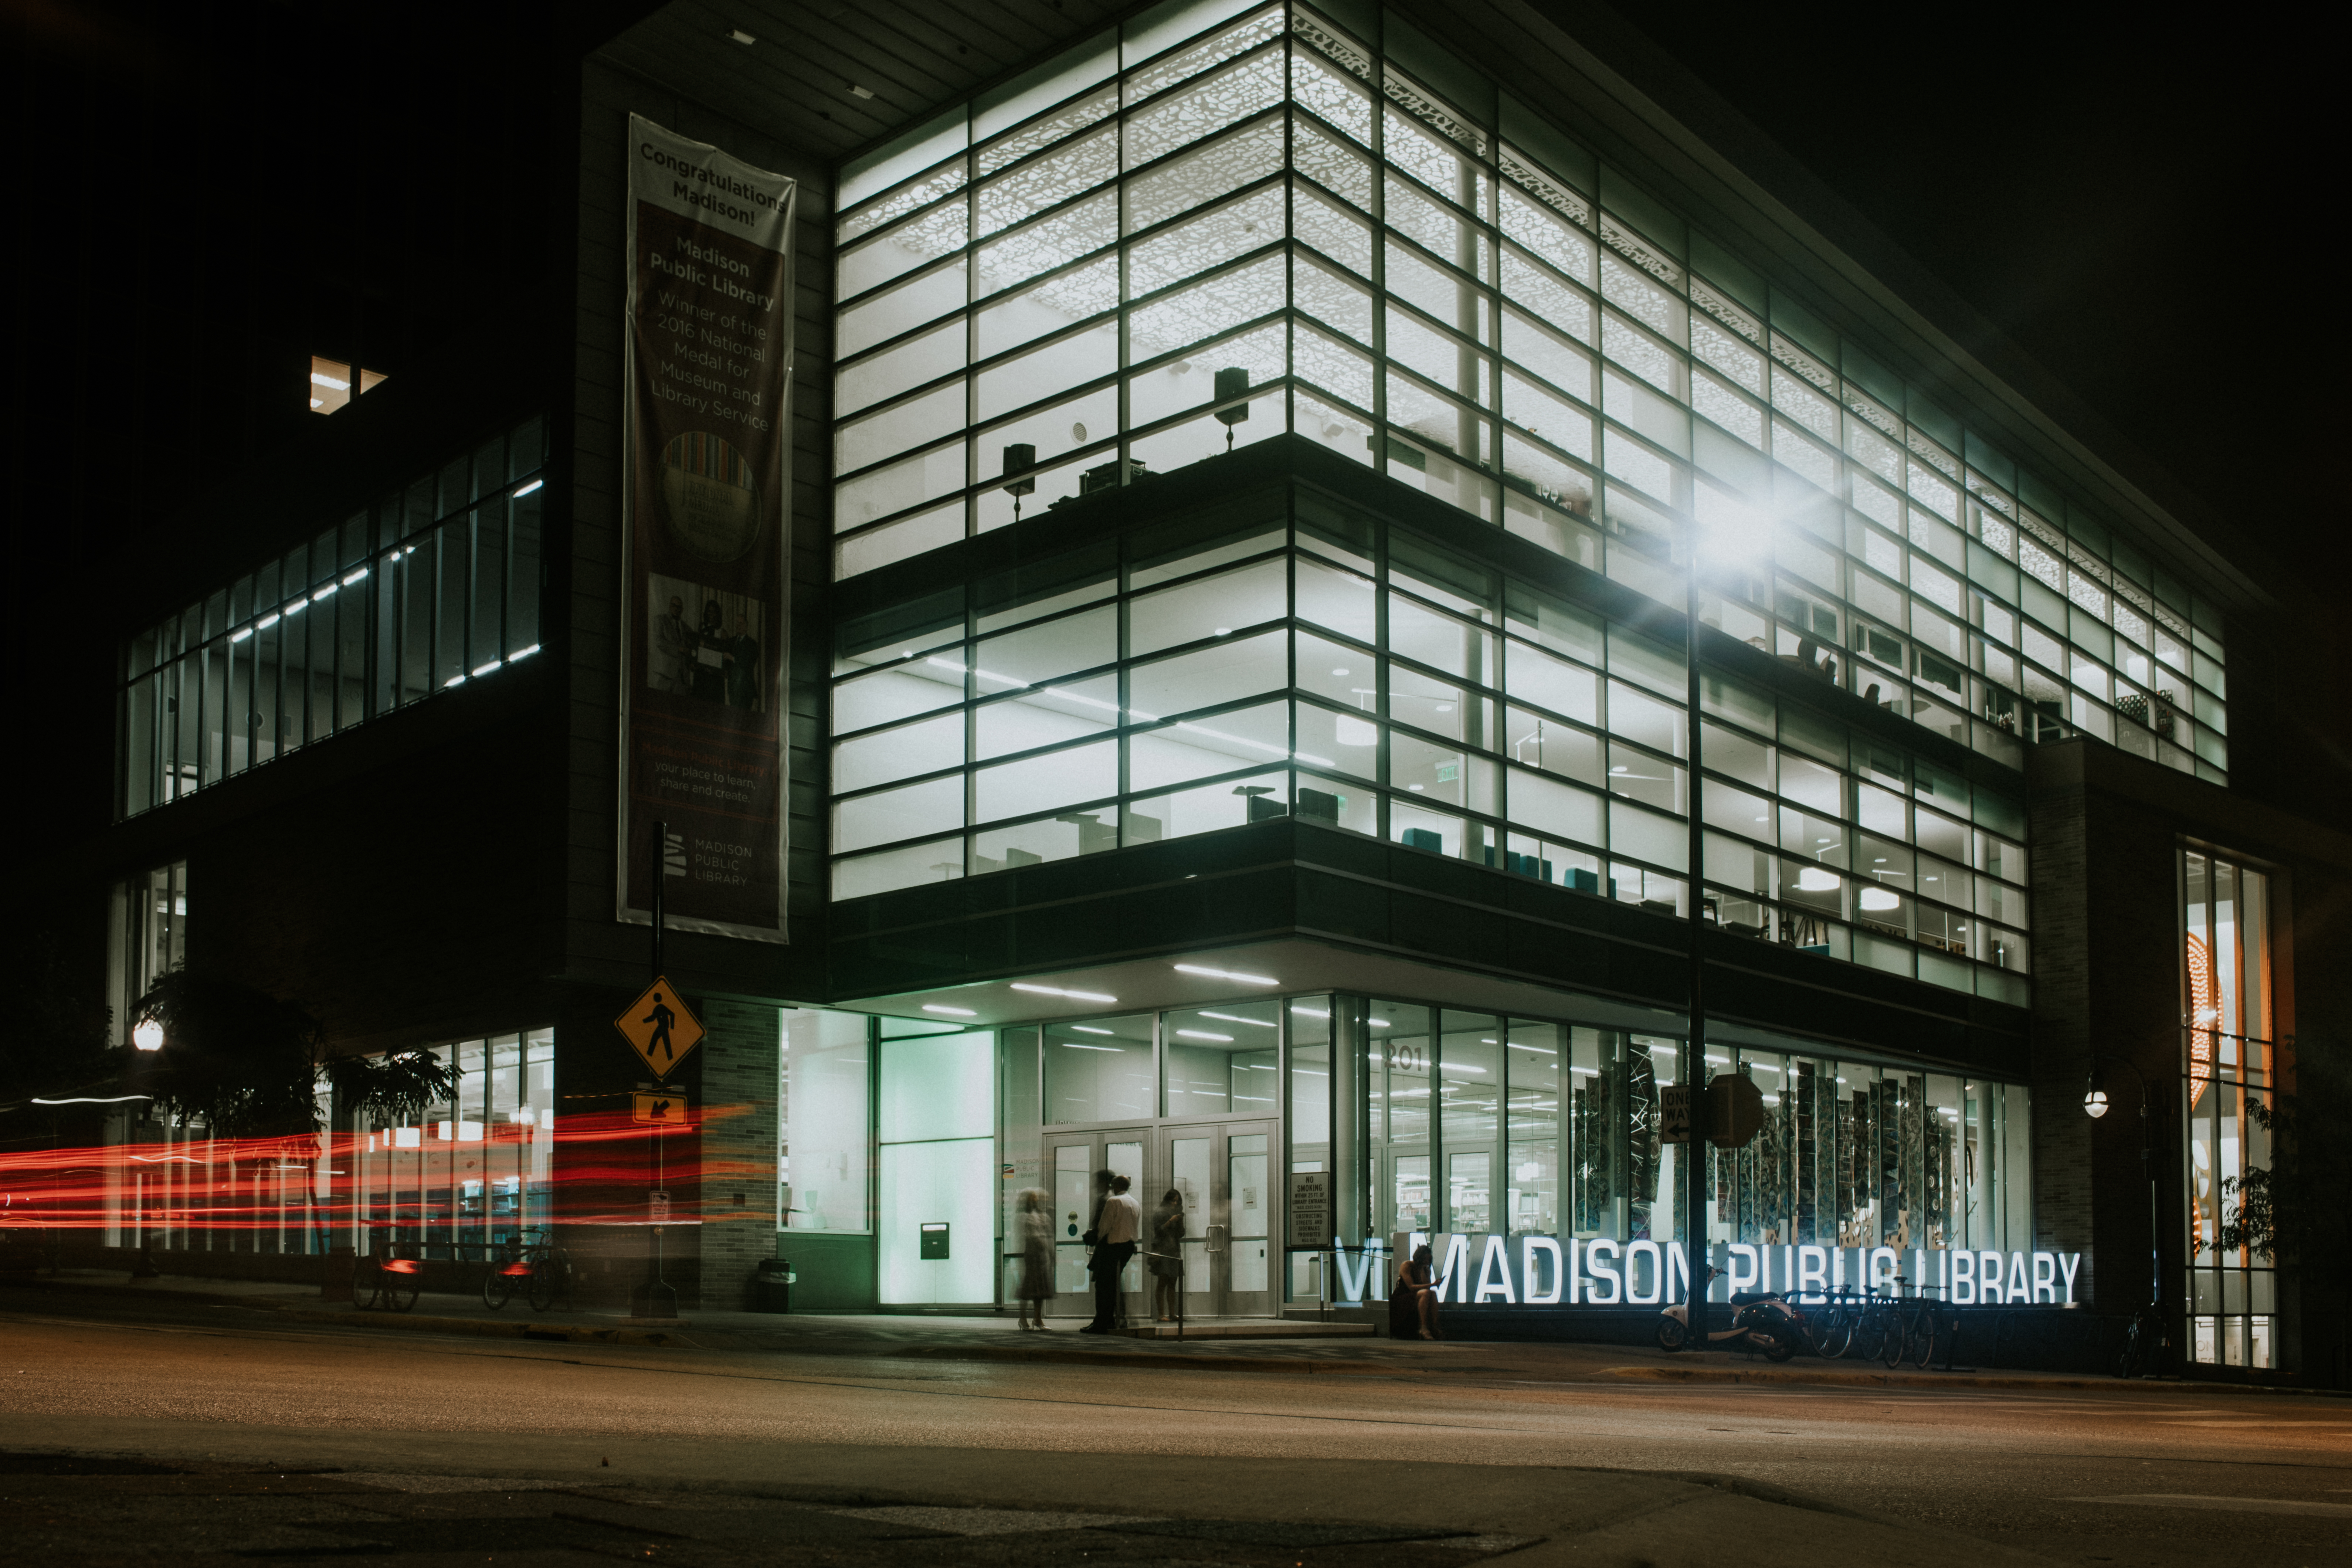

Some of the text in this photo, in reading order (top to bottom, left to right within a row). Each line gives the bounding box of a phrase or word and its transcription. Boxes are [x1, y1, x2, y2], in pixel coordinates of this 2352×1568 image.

[641, 143, 785, 214] Congratulations
[673, 181, 755, 227] Madison!
[678, 237, 749, 278] Madison
[651, 253, 774, 312] Public Library
[658, 290, 767, 340] Winner of the
[658, 313, 765, 363] 2016 National
[675, 343, 750, 379] Medal for
[662, 361, 760, 406] Museum and
[652, 381, 768, 432] Library Service
[642, 742, 687, 759] Madison
[691, 751, 723, 767] Public
[655, 762, 756, 790] your place to learn,
[661, 777, 751, 802] share and create.
[1442, 767, 1455, 780] EXIT
[696, 839, 752, 858] MADISON
[696, 854, 739, 871] PUBLIC
[696, 869, 748, 886] LIBRARY
[1384, 1044, 1422, 1071] 201
[1667, 1092, 1689, 1106] ONE
[1297, 1184, 1322, 1192] SMOKING
[1409, 1232, 1712, 1304] MADISON
[1728, 1243, 1898, 1304] PUBLIC
[1915, 1248, 2081, 1304] LIBRARY
